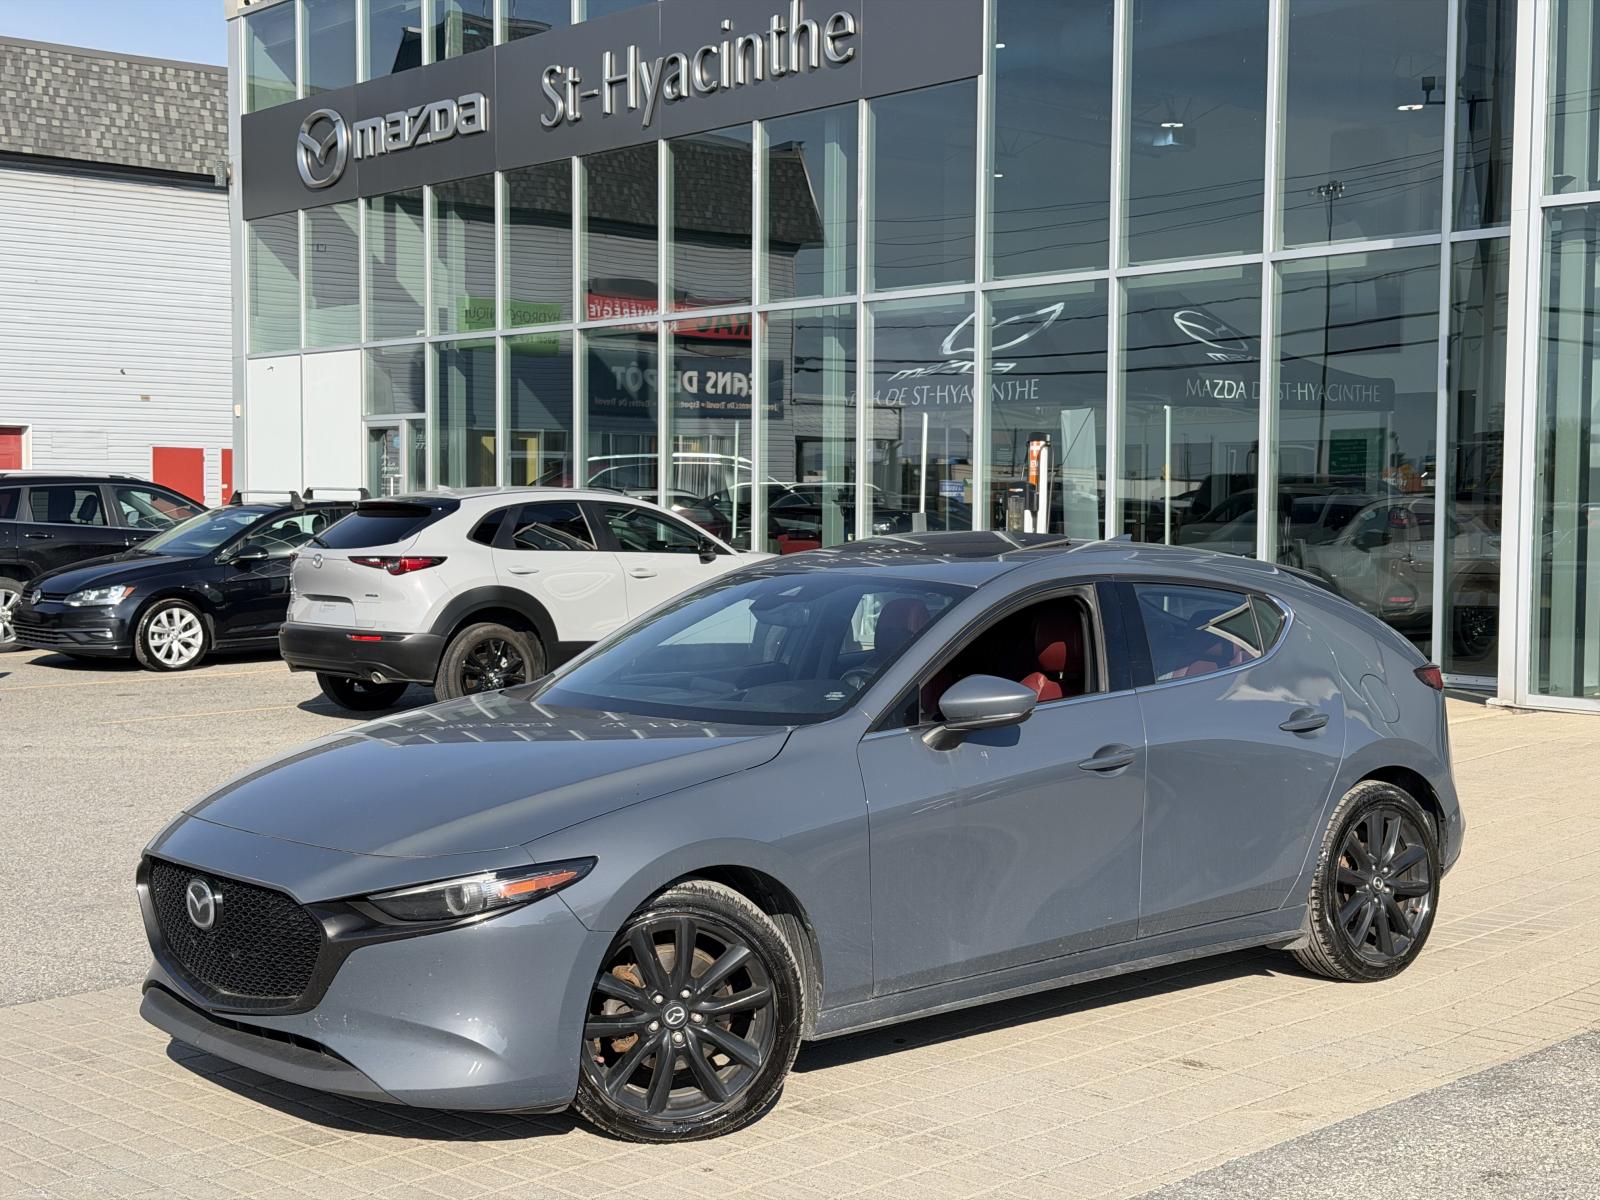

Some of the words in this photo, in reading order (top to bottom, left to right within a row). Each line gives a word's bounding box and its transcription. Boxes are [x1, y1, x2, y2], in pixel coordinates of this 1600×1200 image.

[540, 0, 856, 127] St-Hyacinthe
[885, 387, 908, 406] DE
[911, 378, 1040, 406] ST-HYANTHE
[1185, 377, 1248, 400] MAZDA
